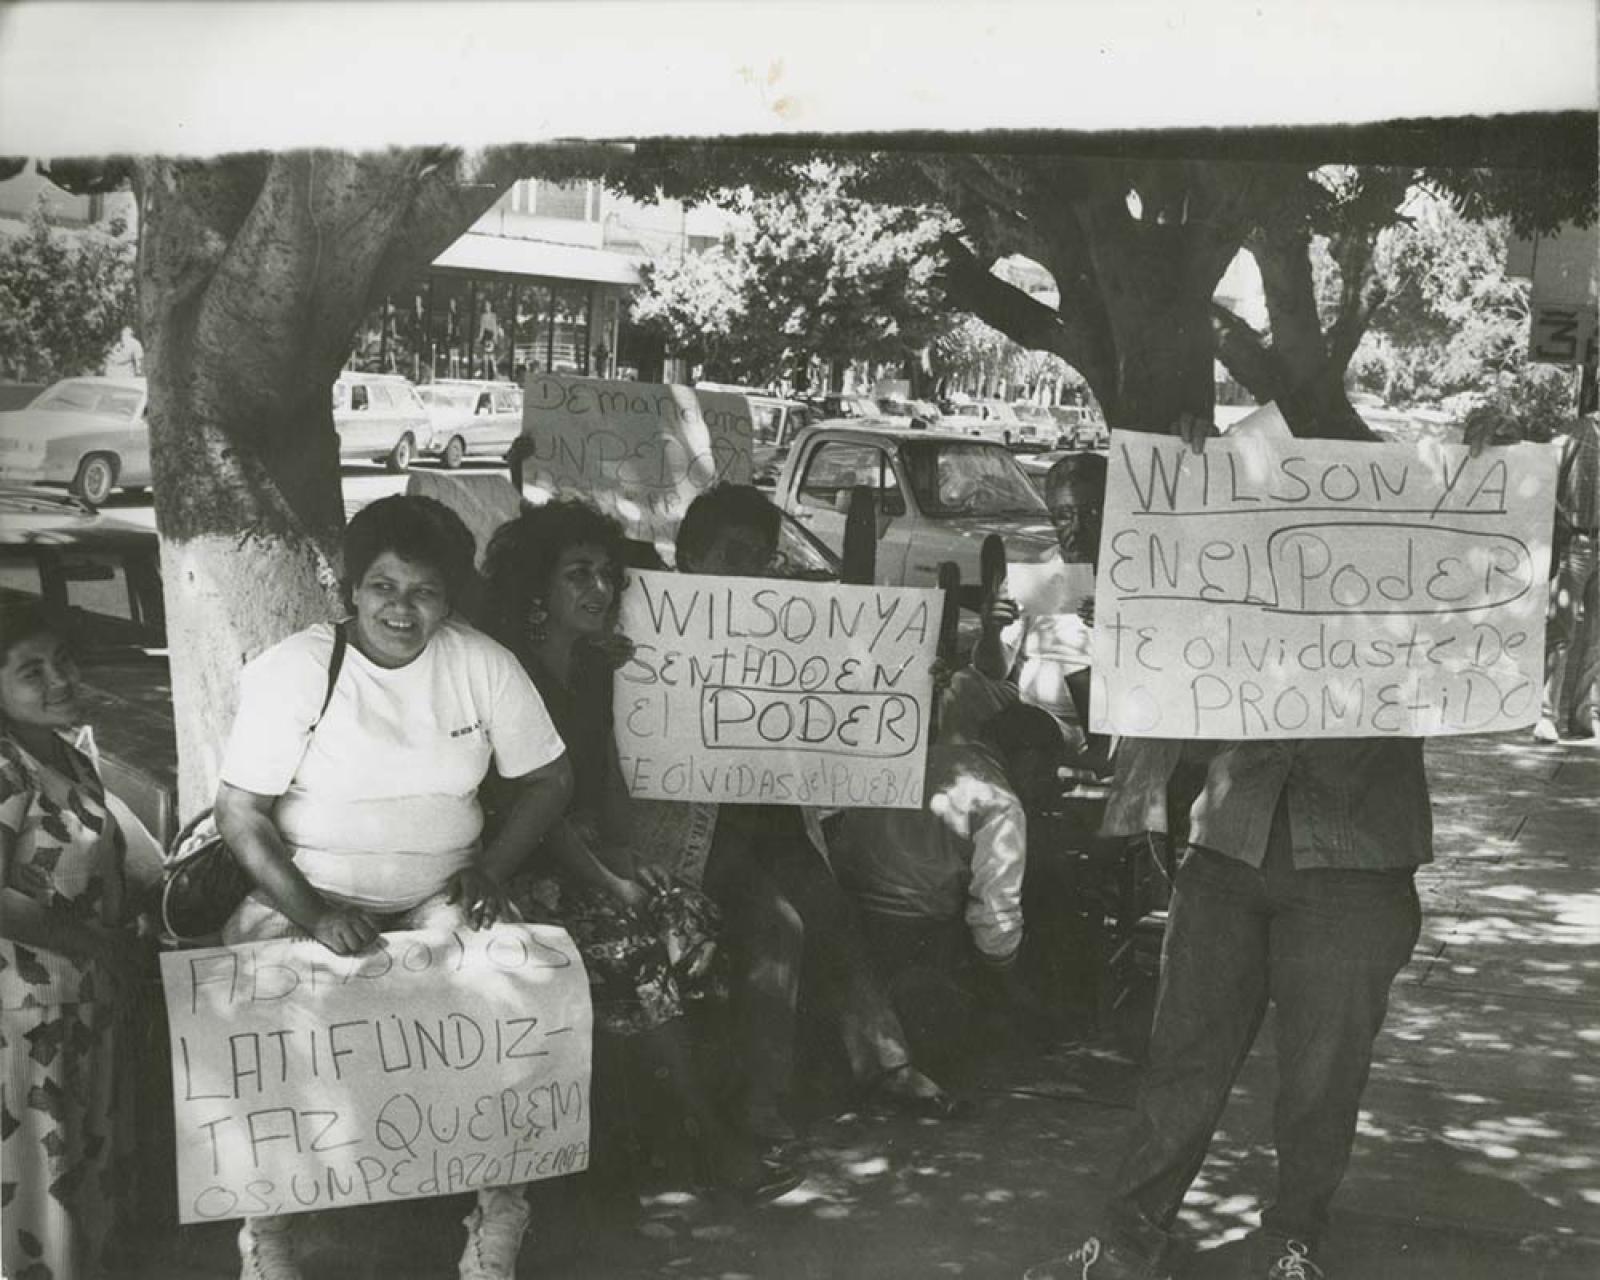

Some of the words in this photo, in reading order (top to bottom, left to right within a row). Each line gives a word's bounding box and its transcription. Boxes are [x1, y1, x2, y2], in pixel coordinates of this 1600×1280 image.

[1121, 442, 1409, 511] WILSON
[1430, 455, 1508, 519] YA
[1110, 529, 1179, 592] EN
[639, 575, 865, 643] WILSON
[868, 592, 928, 652] YA
[834, 655, 914, 693] EN
[708, 687, 905, 745] PODER
[199, 1106, 364, 1176] TAZ
[375, 1080, 582, 1158] QUEREM
[290, 1164, 354, 1206] UN
